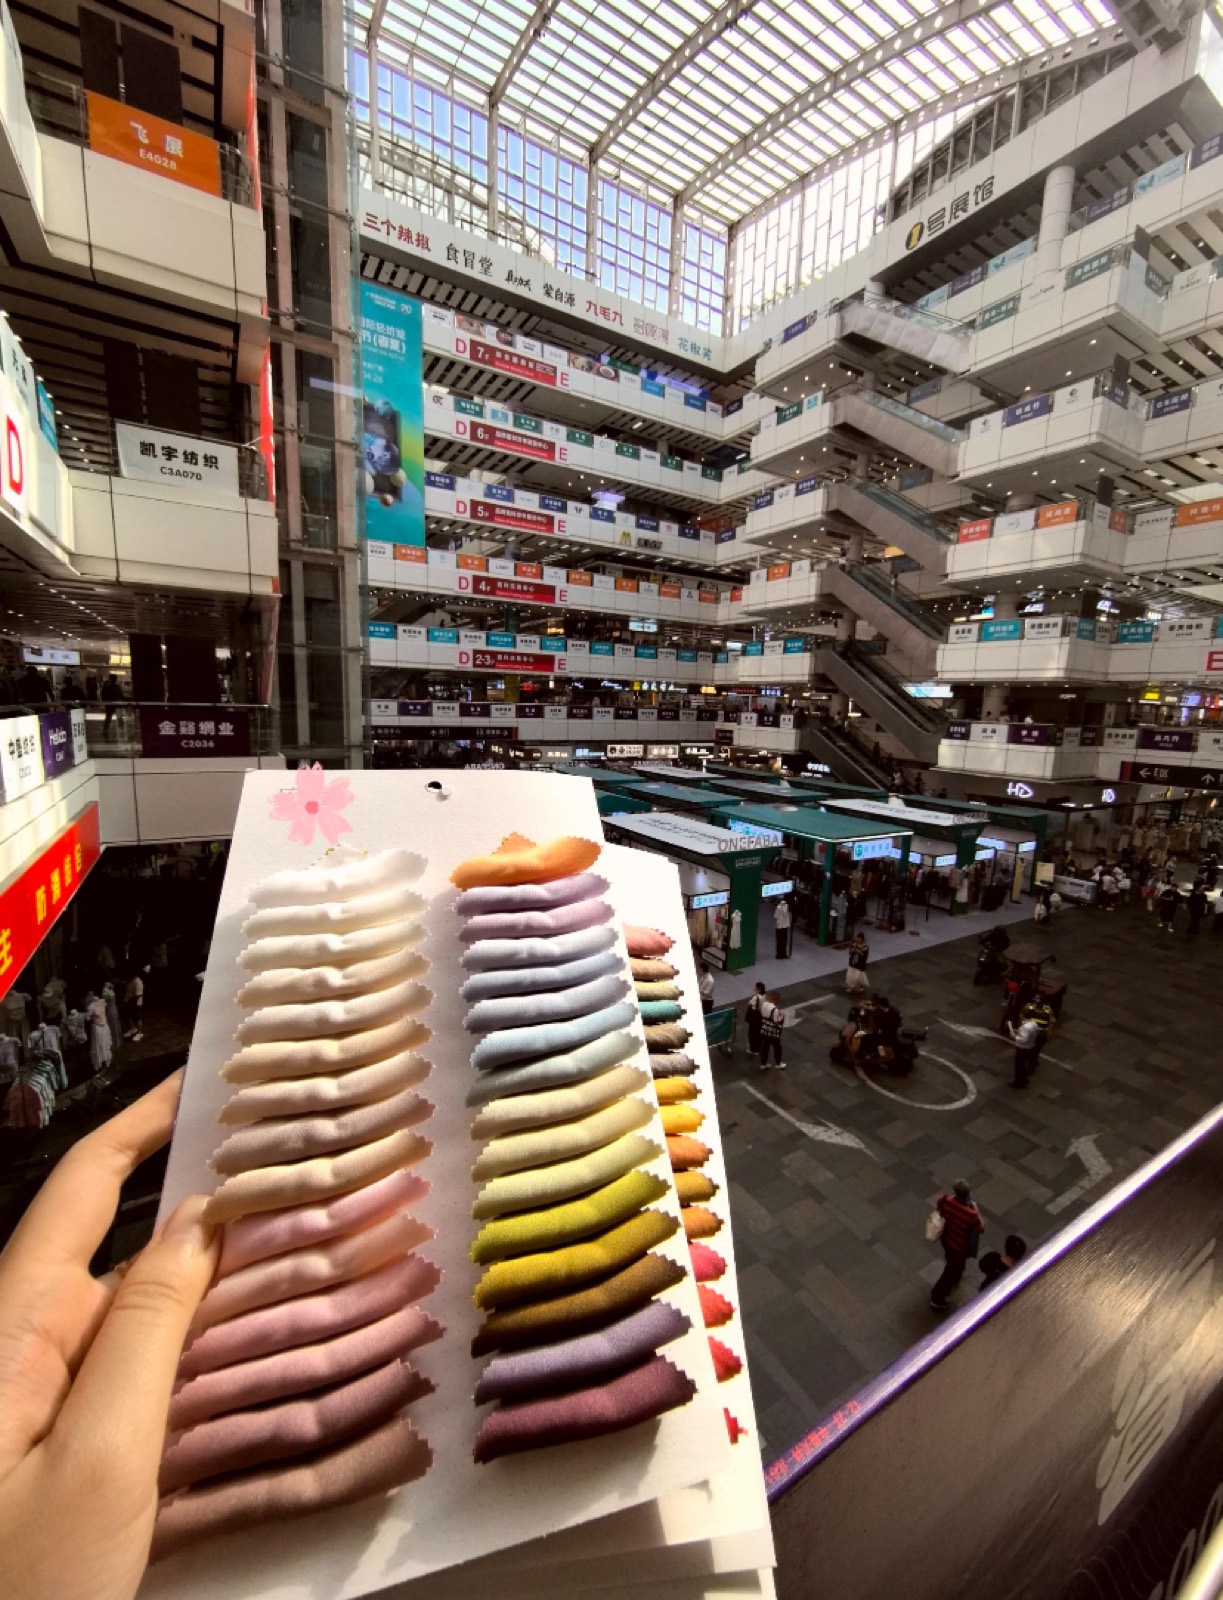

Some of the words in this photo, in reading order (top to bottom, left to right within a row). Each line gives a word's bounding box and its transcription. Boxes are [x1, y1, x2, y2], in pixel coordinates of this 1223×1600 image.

[363, 212, 431, 252] 三个辣椒
[586, 300, 624, 327] 九毛九
[455, 338, 467, 354] D
[560, 372, 569, 387] E
[455, 420, 467, 435] D
[139, 440, 220, 470] 凯宇纺织
[559, 447, 567, 461] E
[455, 500, 467, 514] D
[558, 519, 566, 533] E
[458, 576, 469, 590] D
[560, 589, 567, 601] E
[459, 652, 469, 666] D
[558, 658, 566, 671] E
[717, 834, 780, 852] ONEFABA
